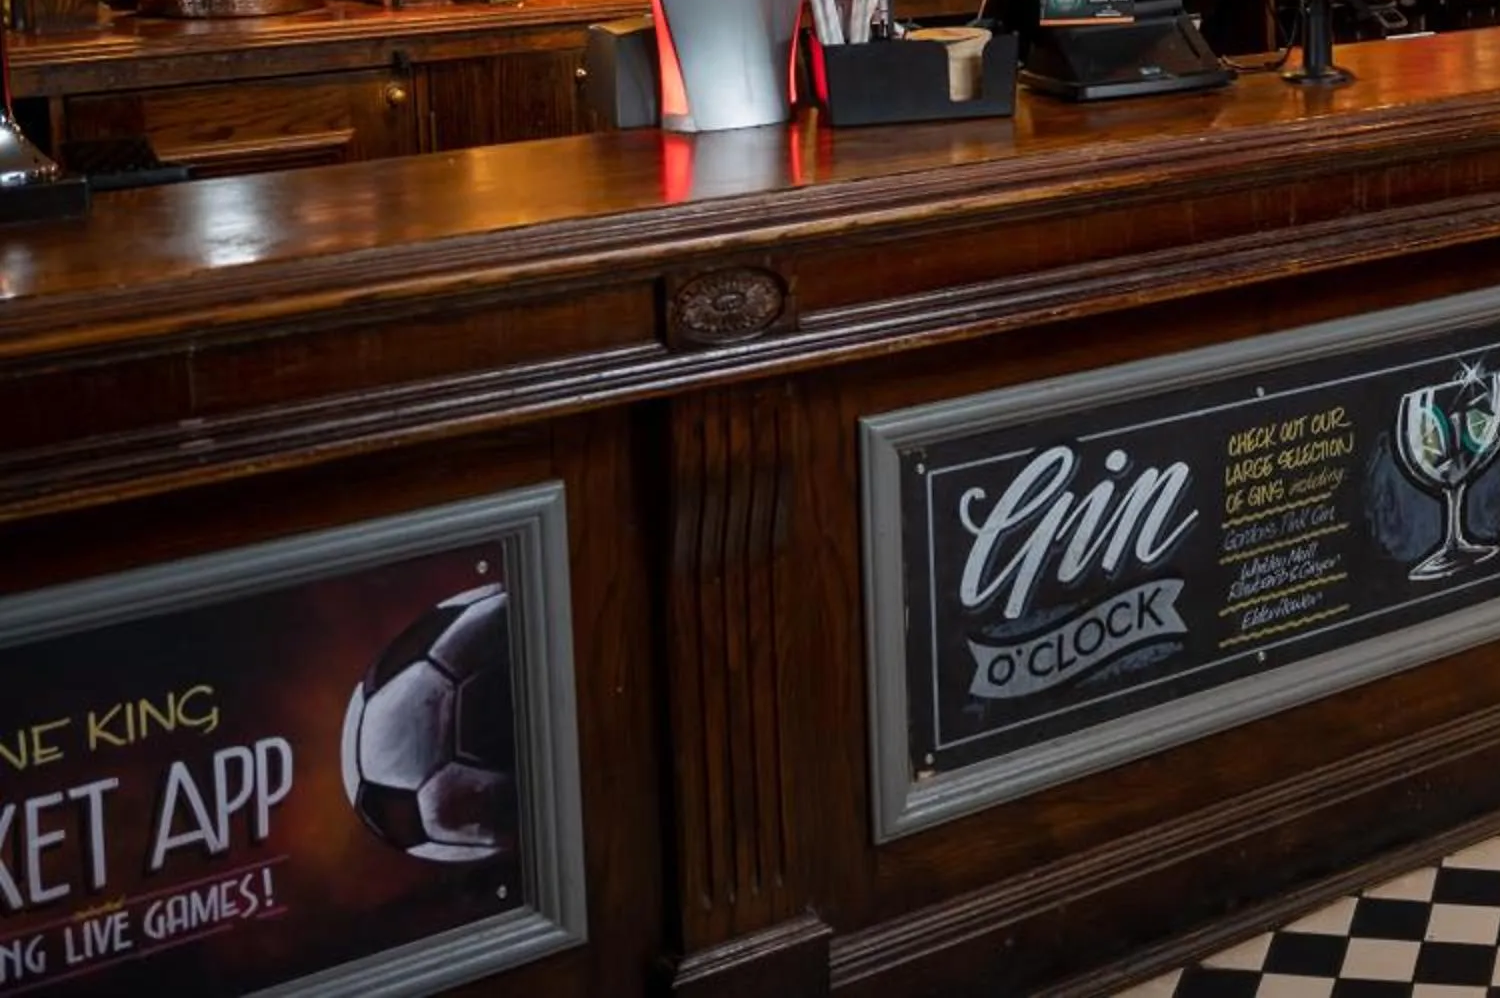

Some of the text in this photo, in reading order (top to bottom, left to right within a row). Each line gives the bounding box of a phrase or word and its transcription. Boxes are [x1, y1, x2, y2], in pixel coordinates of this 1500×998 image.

[1225, 432, 1355, 487] LARGE SELECTION
[1228, 406, 1351, 457] CHECK OUT OUR
[959, 445, 1199, 619] Gin
[1225, 489, 1244, 514] OF
[1249, 479, 1285, 507] GINS
[987, 587, 1164, 687] O'CLOCK
[88, 685, 220, 751] KING
[150, 737, 294, 873] APP
[64, 910, 133, 965] LIVE
[143, 868, 274, 940] GAMES!
